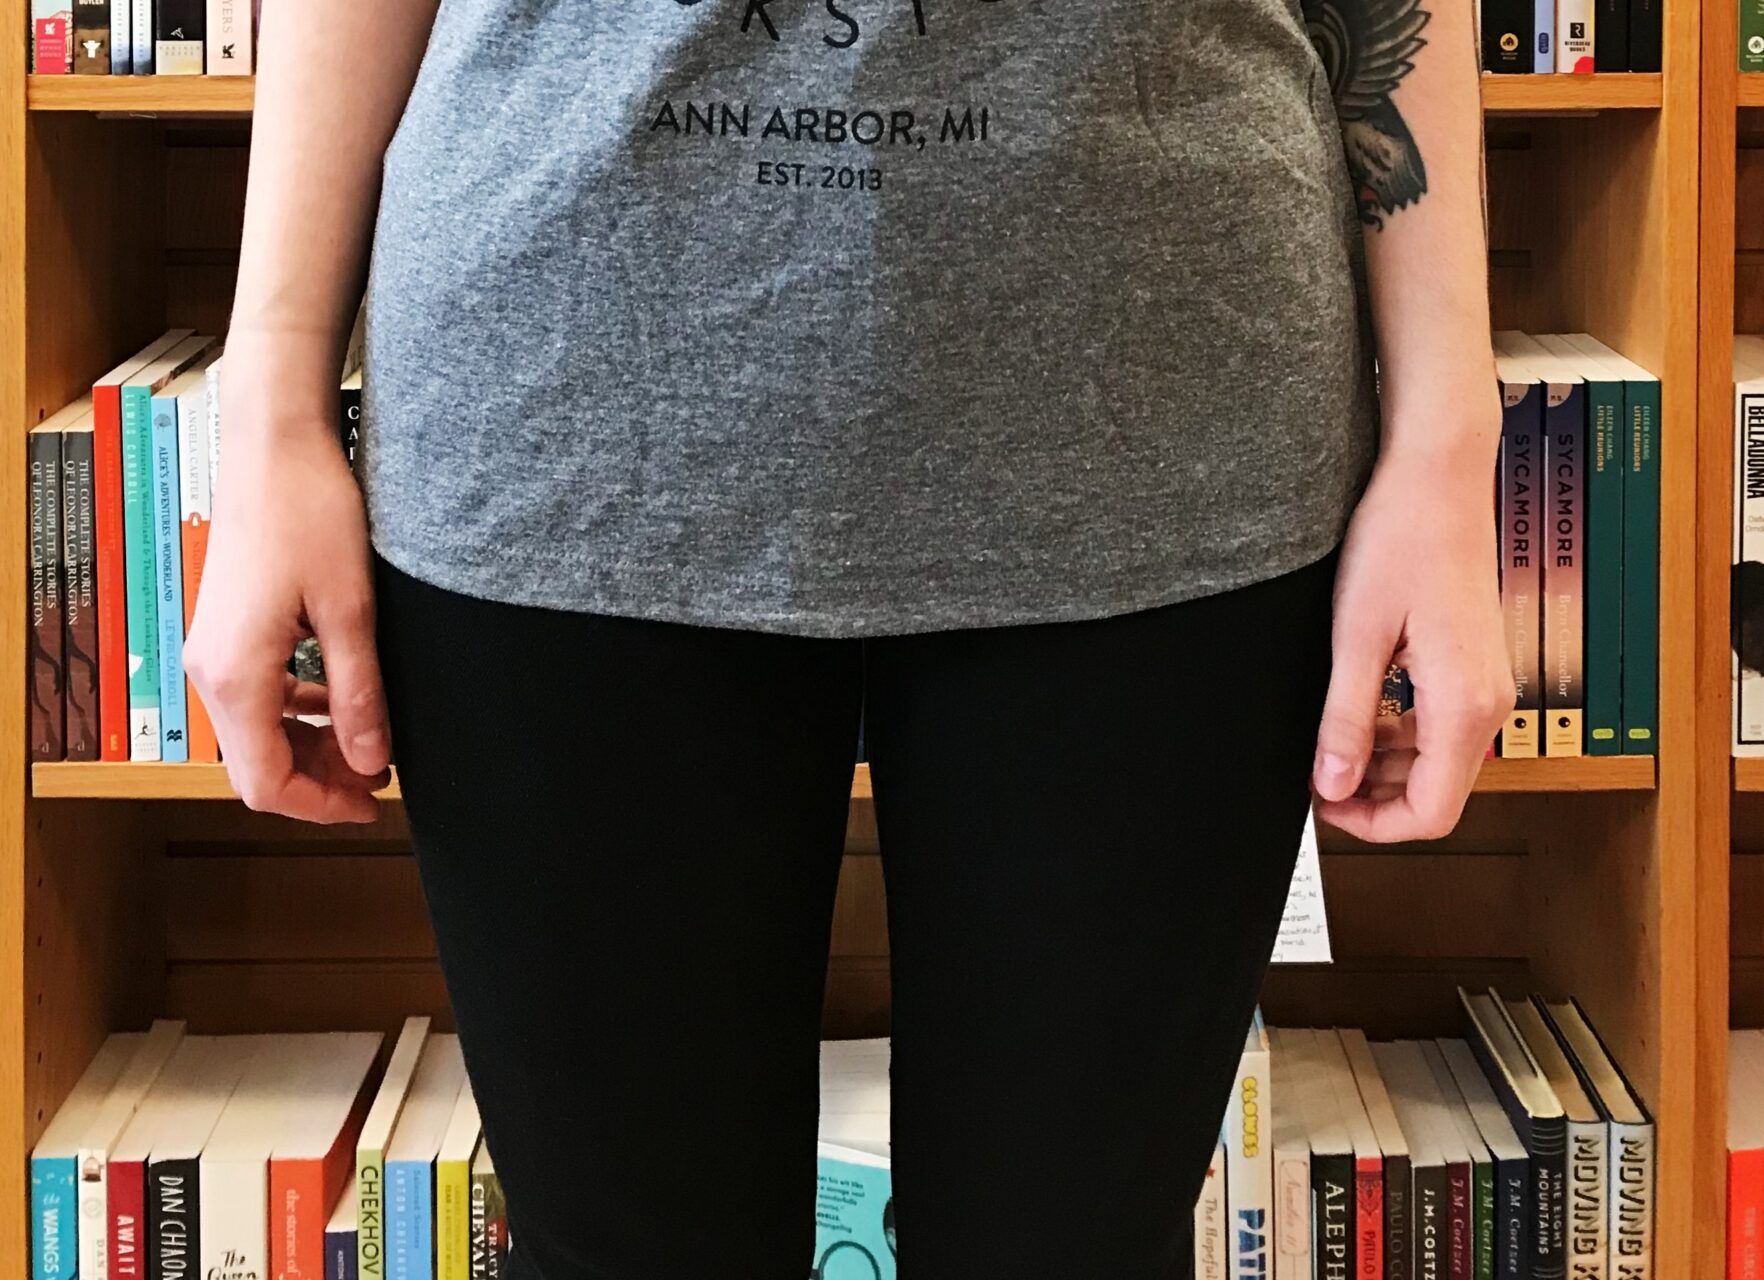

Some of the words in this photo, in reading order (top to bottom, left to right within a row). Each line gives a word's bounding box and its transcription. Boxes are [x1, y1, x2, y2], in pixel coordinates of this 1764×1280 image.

[651, 100, 750, 137] ANN
[762, 107, 925, 151] ARBOR,
[940, 107, 989, 142] MI
[757, 161, 808, 187] EST.
[822, 166, 883, 191] 2013
[126, 394, 136, 435] LEWIS
[188, 409, 198, 454] ANGELA
[33, 461, 41, 477] OF
[46, 461, 56, 485] THE
[66, 460, 76, 476] OF
[80, 460, 90, 484] THE
[127, 445, 138, 504] CARROLL
[159, 446, 170, 478] ALICE'S
[189, 458, 199, 500] CARTER
[1747, 405, 1764, 499] BELLADONNA
[32, 481, 43, 540] LEONORA
[46, 490, 57, 555] COMPLETE
[66, 481, 77, 540] LEONORA
[80, 489, 90, 554] COMPLETE
[160, 481, 172, 537] ADVENTURES
[1513, 434, 1529, 568] SYCAMORE
[1557, 434, 1573, 568] SYCAMORE
[33, 543, 43, 626] CARRINGTON
[47, 559, 57, 608] STORIES
[67, 543, 77, 625] CARRINGTON
[80, 558, 91, 607] STORIES
[162, 542, 173, 602] WONDERLAND
[166, 620, 175, 653] LEWIS
[1558, 630, 1571, 697] Chancellor
[167, 657, 177, 707] CARROLL
[1241, 1076, 1258, 1158] CLOWES
[158, 1176, 186, 1213] DAN
[286, 1190, 301, 1206] the
[1538, 1168, 1550, 1255] MOUNTAINS
[1553, 1172, 1562, 1199] THE
[1574, 1135, 1600, 1255] MOVING
[1619, 1135, 1645, 1256] MOVING
[43, 1209, 59, 1273] WANGS
[117, 1215, 135, 1275] AWAIT
[287, 1208, 298, 1255] stories
[361, 1166, 379, 1274] CHEKHOV
[1326, 1181, 1346, 1280] ALEPH
[1553, 1206, 1562, 1248] EIGHT
[288, 1259, 300, 1275] of
[488, 1223, 498, 1279] TRACY
[1365, 1230, 1376, 1274] PAULO
